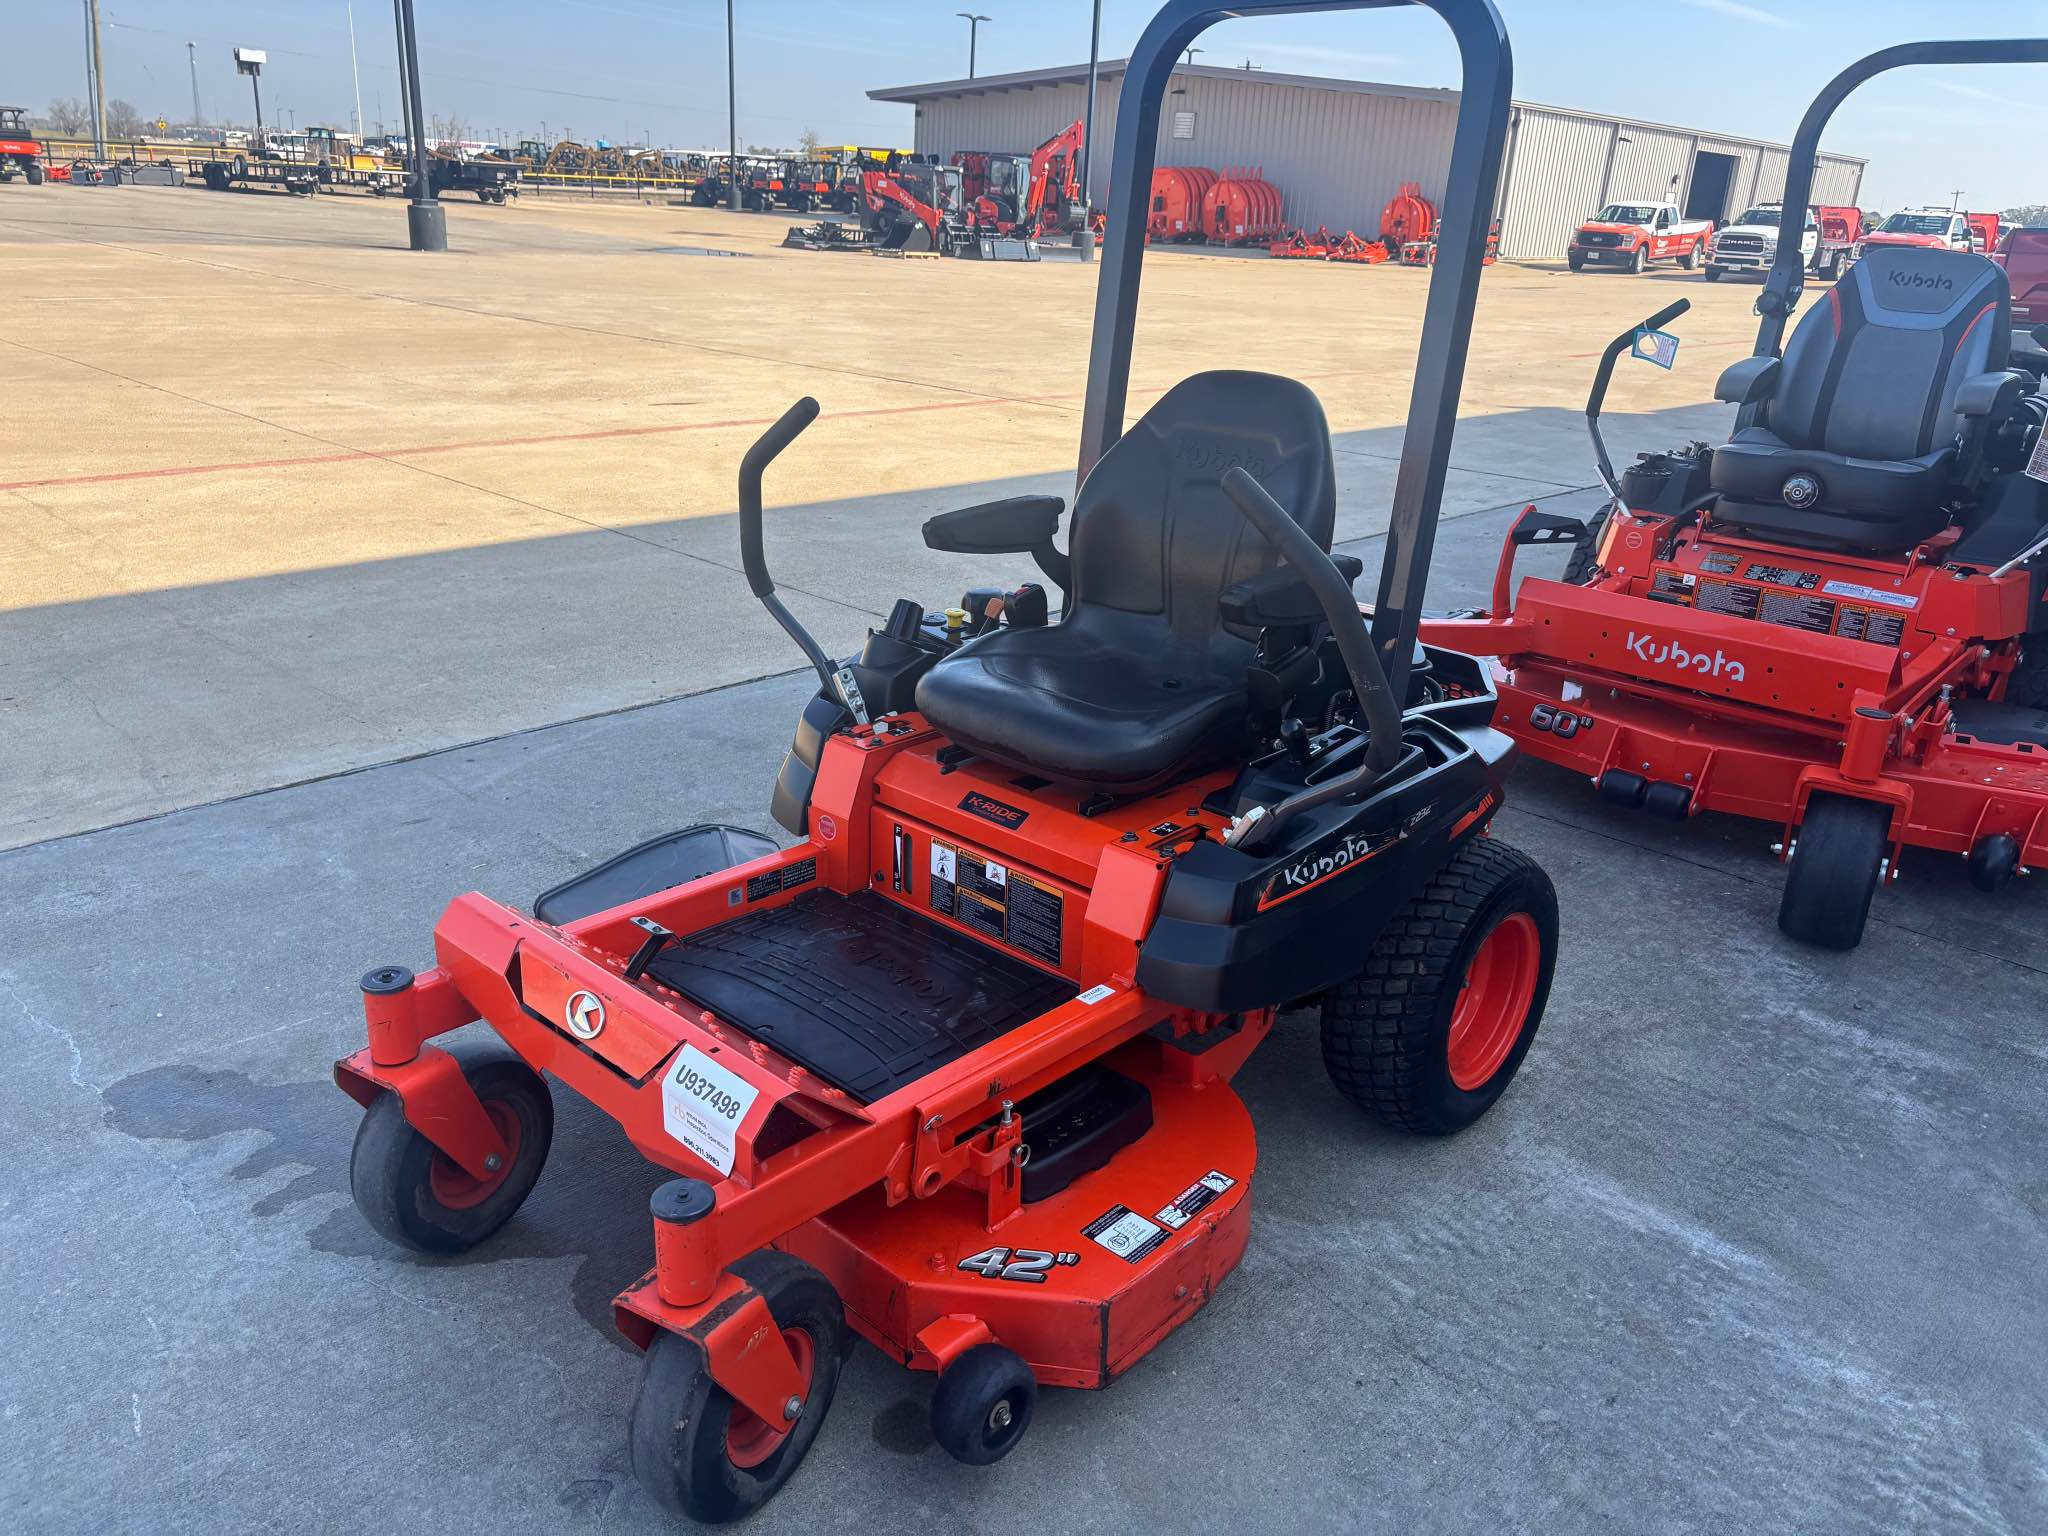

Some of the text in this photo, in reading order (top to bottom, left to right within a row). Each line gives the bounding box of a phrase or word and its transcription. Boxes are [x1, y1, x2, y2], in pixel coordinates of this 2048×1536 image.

[1889, 270, 1953, 290] Kubota
[1626, 631, 1745, 682] Kubota
[1528, 703, 1594, 738] 60"
[967, 797, 1022, 821] K-RIDE
[1284, 838, 1370, 886] Kubota
[675, 1064, 741, 1120] U937498
[957, 1247, 1081, 1284] 42"
